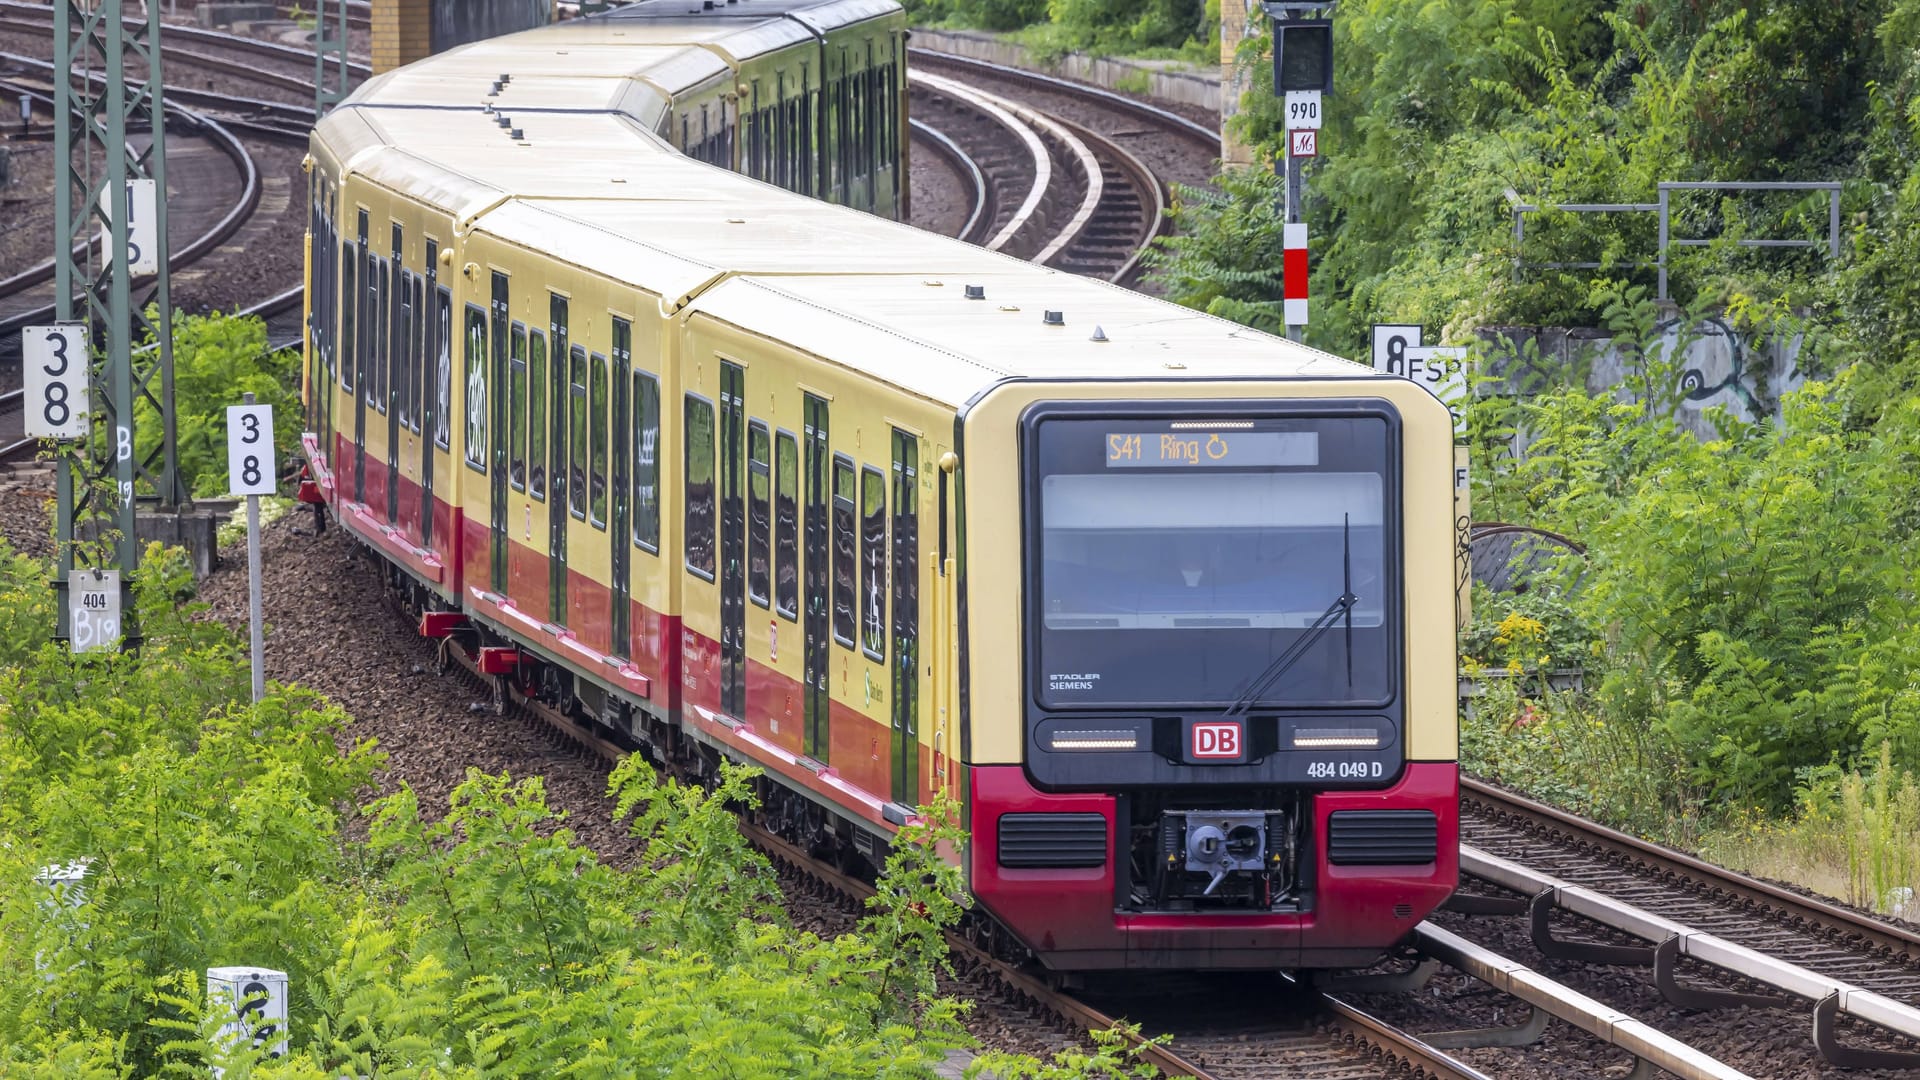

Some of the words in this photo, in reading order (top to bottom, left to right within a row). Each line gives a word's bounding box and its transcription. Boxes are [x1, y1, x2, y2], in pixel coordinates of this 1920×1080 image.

[1291, 102, 1316, 119] 990
[1295, 134, 1313, 152] M
[43, 332, 68, 377] 3
[44, 381, 69, 426] 8
[241, 413, 260, 444] 3
[116, 425, 131, 462] B
[1109, 434, 1141, 460] S41
[1160, 434, 1199, 464] Ring
[242, 455, 261, 486] 8
[83, 593, 106, 608] 404
[1049, 673, 1101, 681] STADLER
[1049, 681, 1093, 690] SIEMENS
[1199, 728, 1236, 752] DB
[1307, 762, 1336, 777] 484
[1339, 762, 1367, 777] 049
[1372, 762, 1382, 777] D
